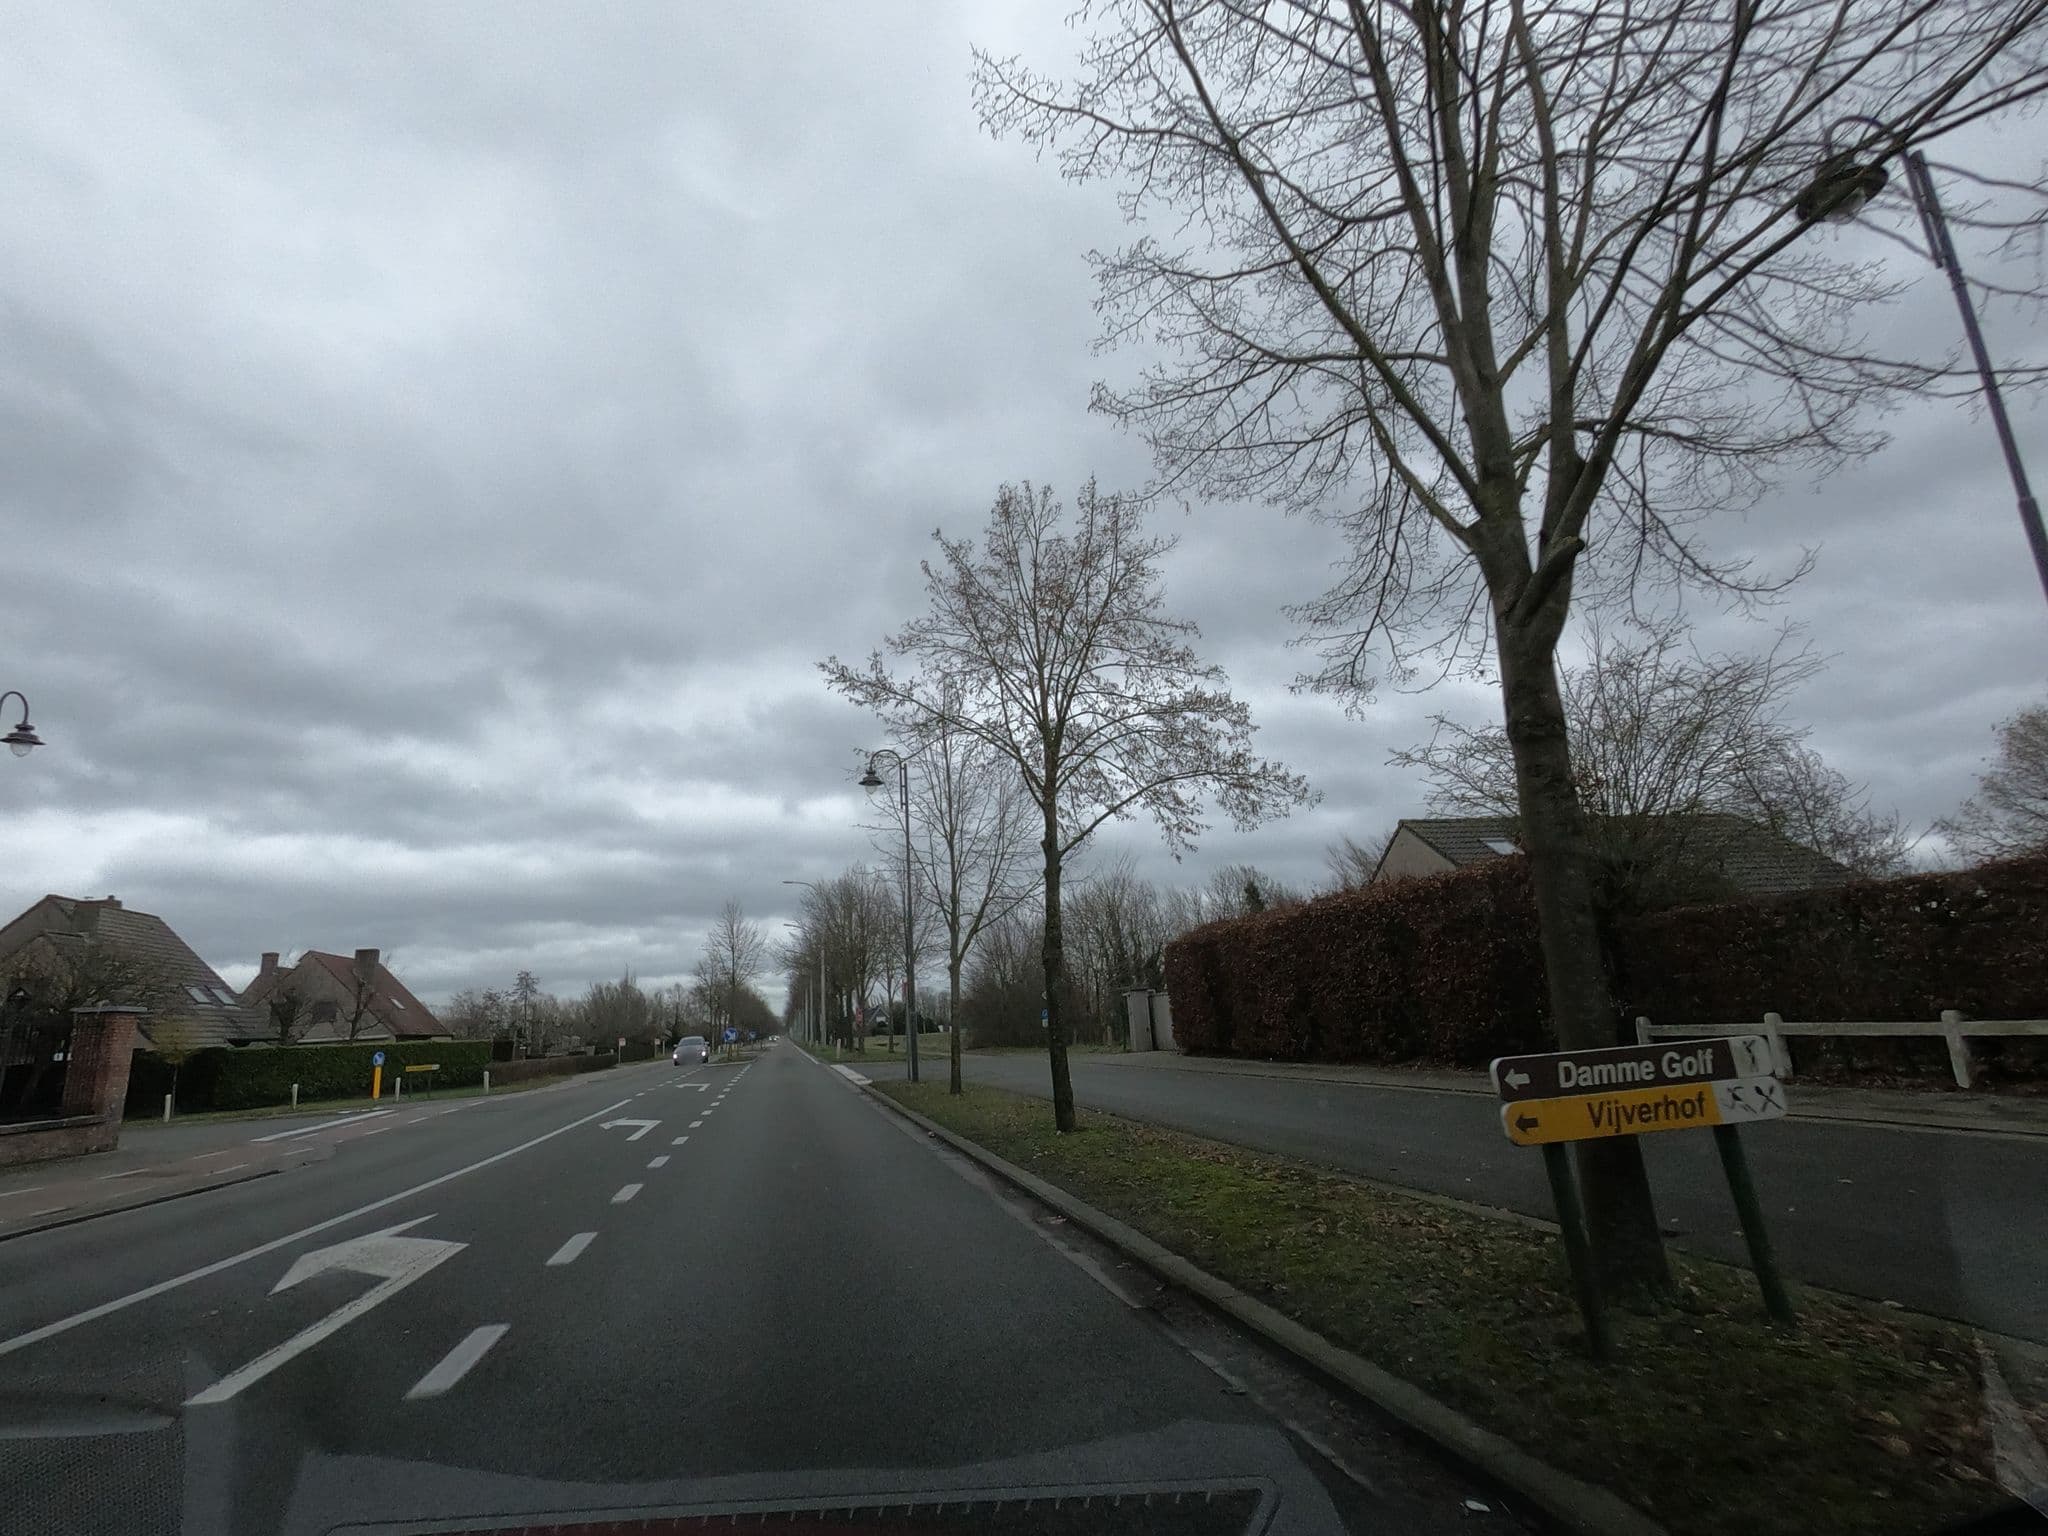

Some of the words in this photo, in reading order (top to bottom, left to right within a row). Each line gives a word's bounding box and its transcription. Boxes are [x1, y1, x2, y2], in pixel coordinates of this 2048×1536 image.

[1557, 1060, 1656, 1089] Damme
[1660, 1048, 1714, 1078] Golf
[1586, 1091, 1706, 1134] Vijverhof
